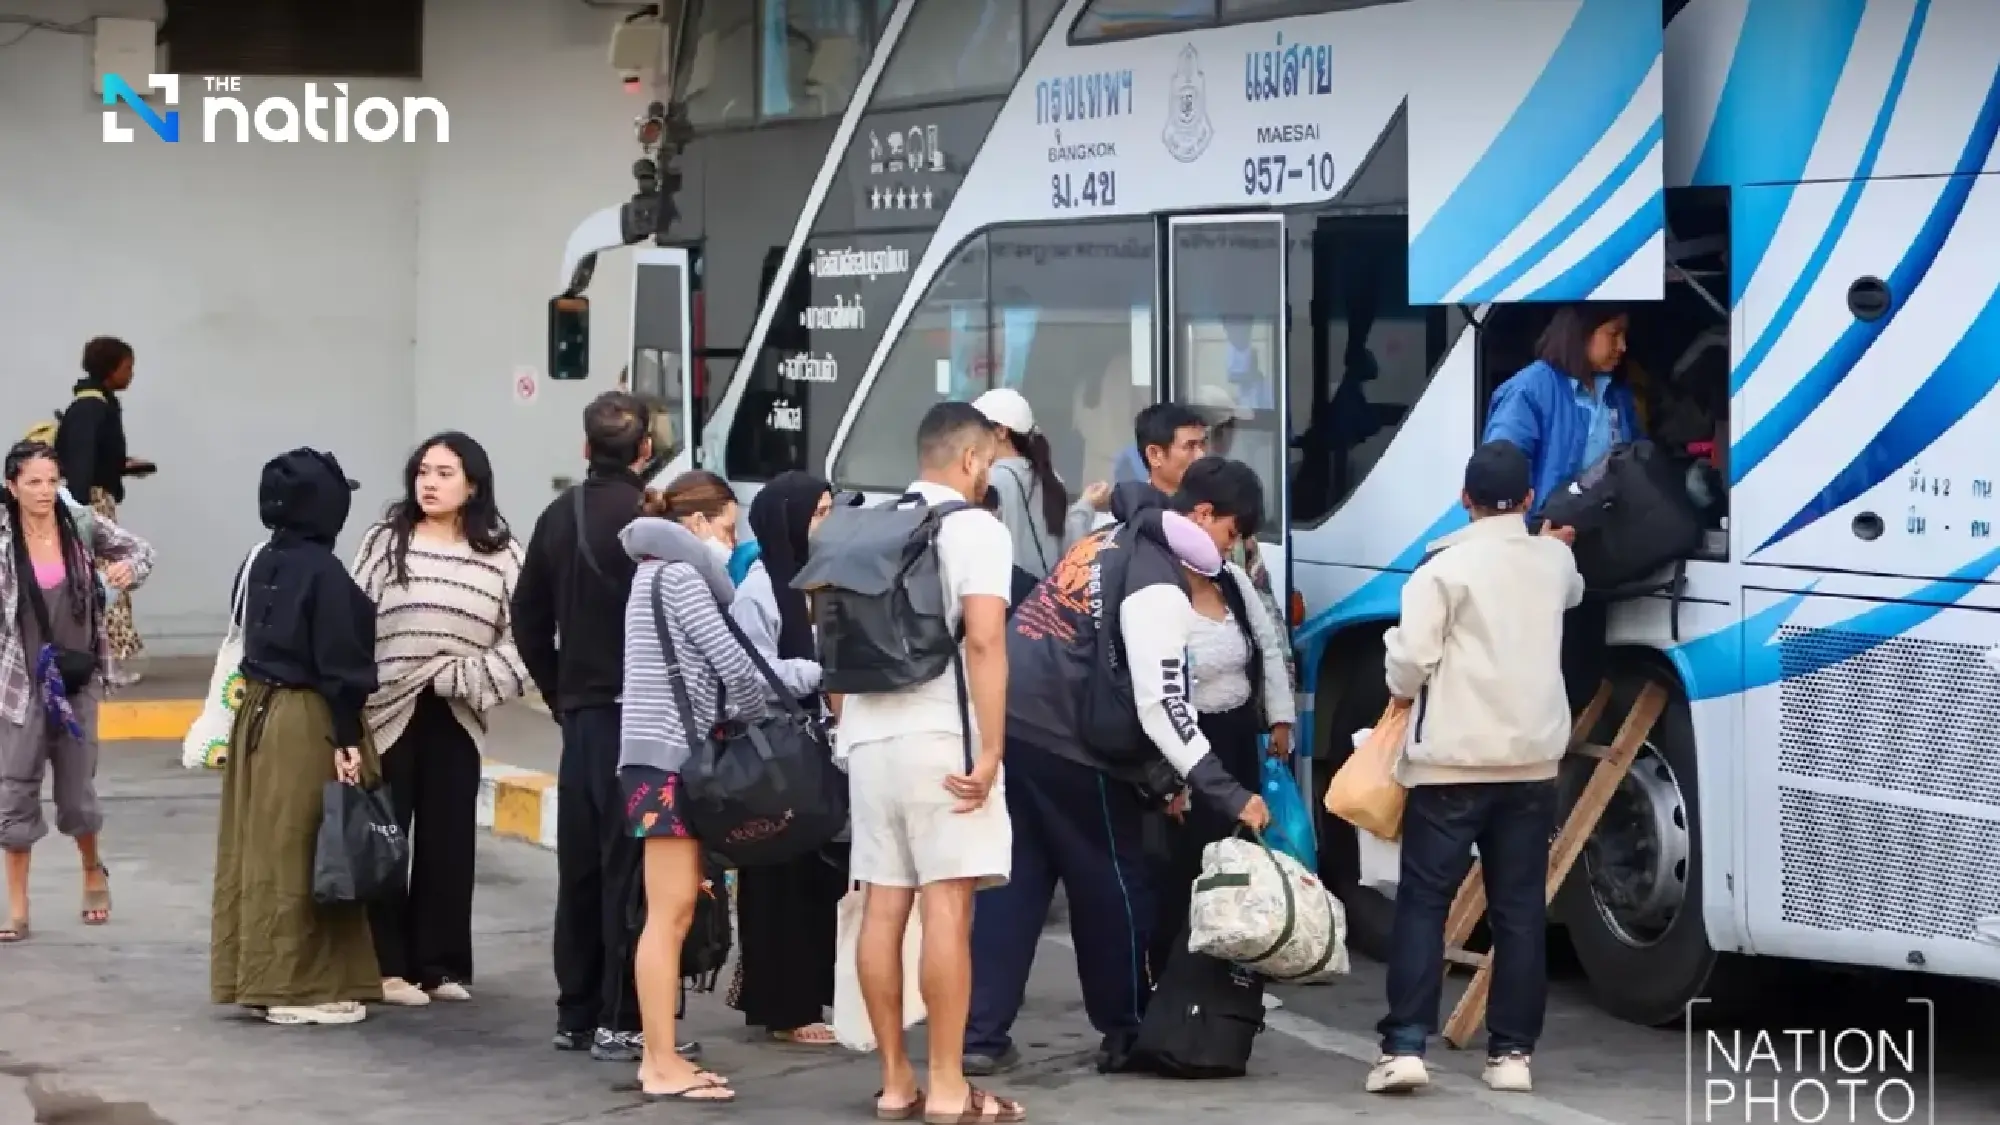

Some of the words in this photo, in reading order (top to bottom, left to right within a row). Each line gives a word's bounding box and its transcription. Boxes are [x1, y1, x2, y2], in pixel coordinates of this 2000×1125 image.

[1246, 31, 1333, 102] แม่สาย
[1035, 69, 1134, 144] กรุงเทพฯ
[1048, 142, 1117, 163] BANGKOK
[1257, 123, 1321, 143] MAESAI
[1244, 151, 1335, 195] 957-10
